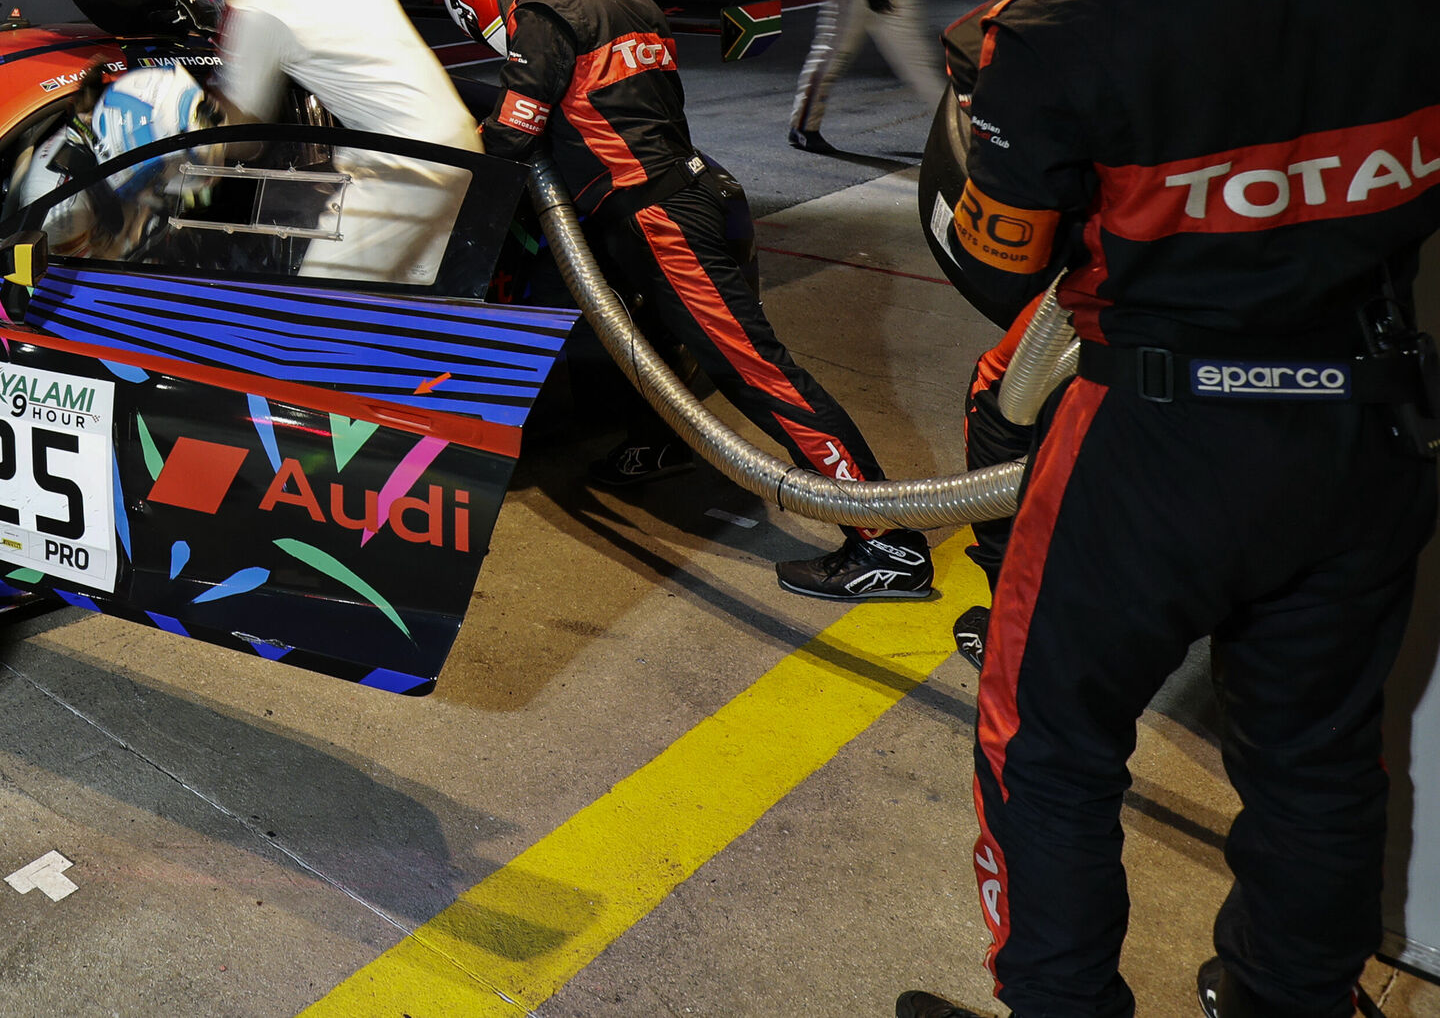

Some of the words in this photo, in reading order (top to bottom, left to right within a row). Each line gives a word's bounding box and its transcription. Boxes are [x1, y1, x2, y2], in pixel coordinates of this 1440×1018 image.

[155, 55, 224, 67] VANTHOOR
[990, 135, 1010, 150] Club
[982, 243, 1029, 263] GROUP
[1196, 363, 1345, 394] sparco
[10, 393, 27, 418] 9
[32, 407, 85, 429] HOUR
[258, 457, 470, 552] Audi
[44, 539, 90, 571] PRO
